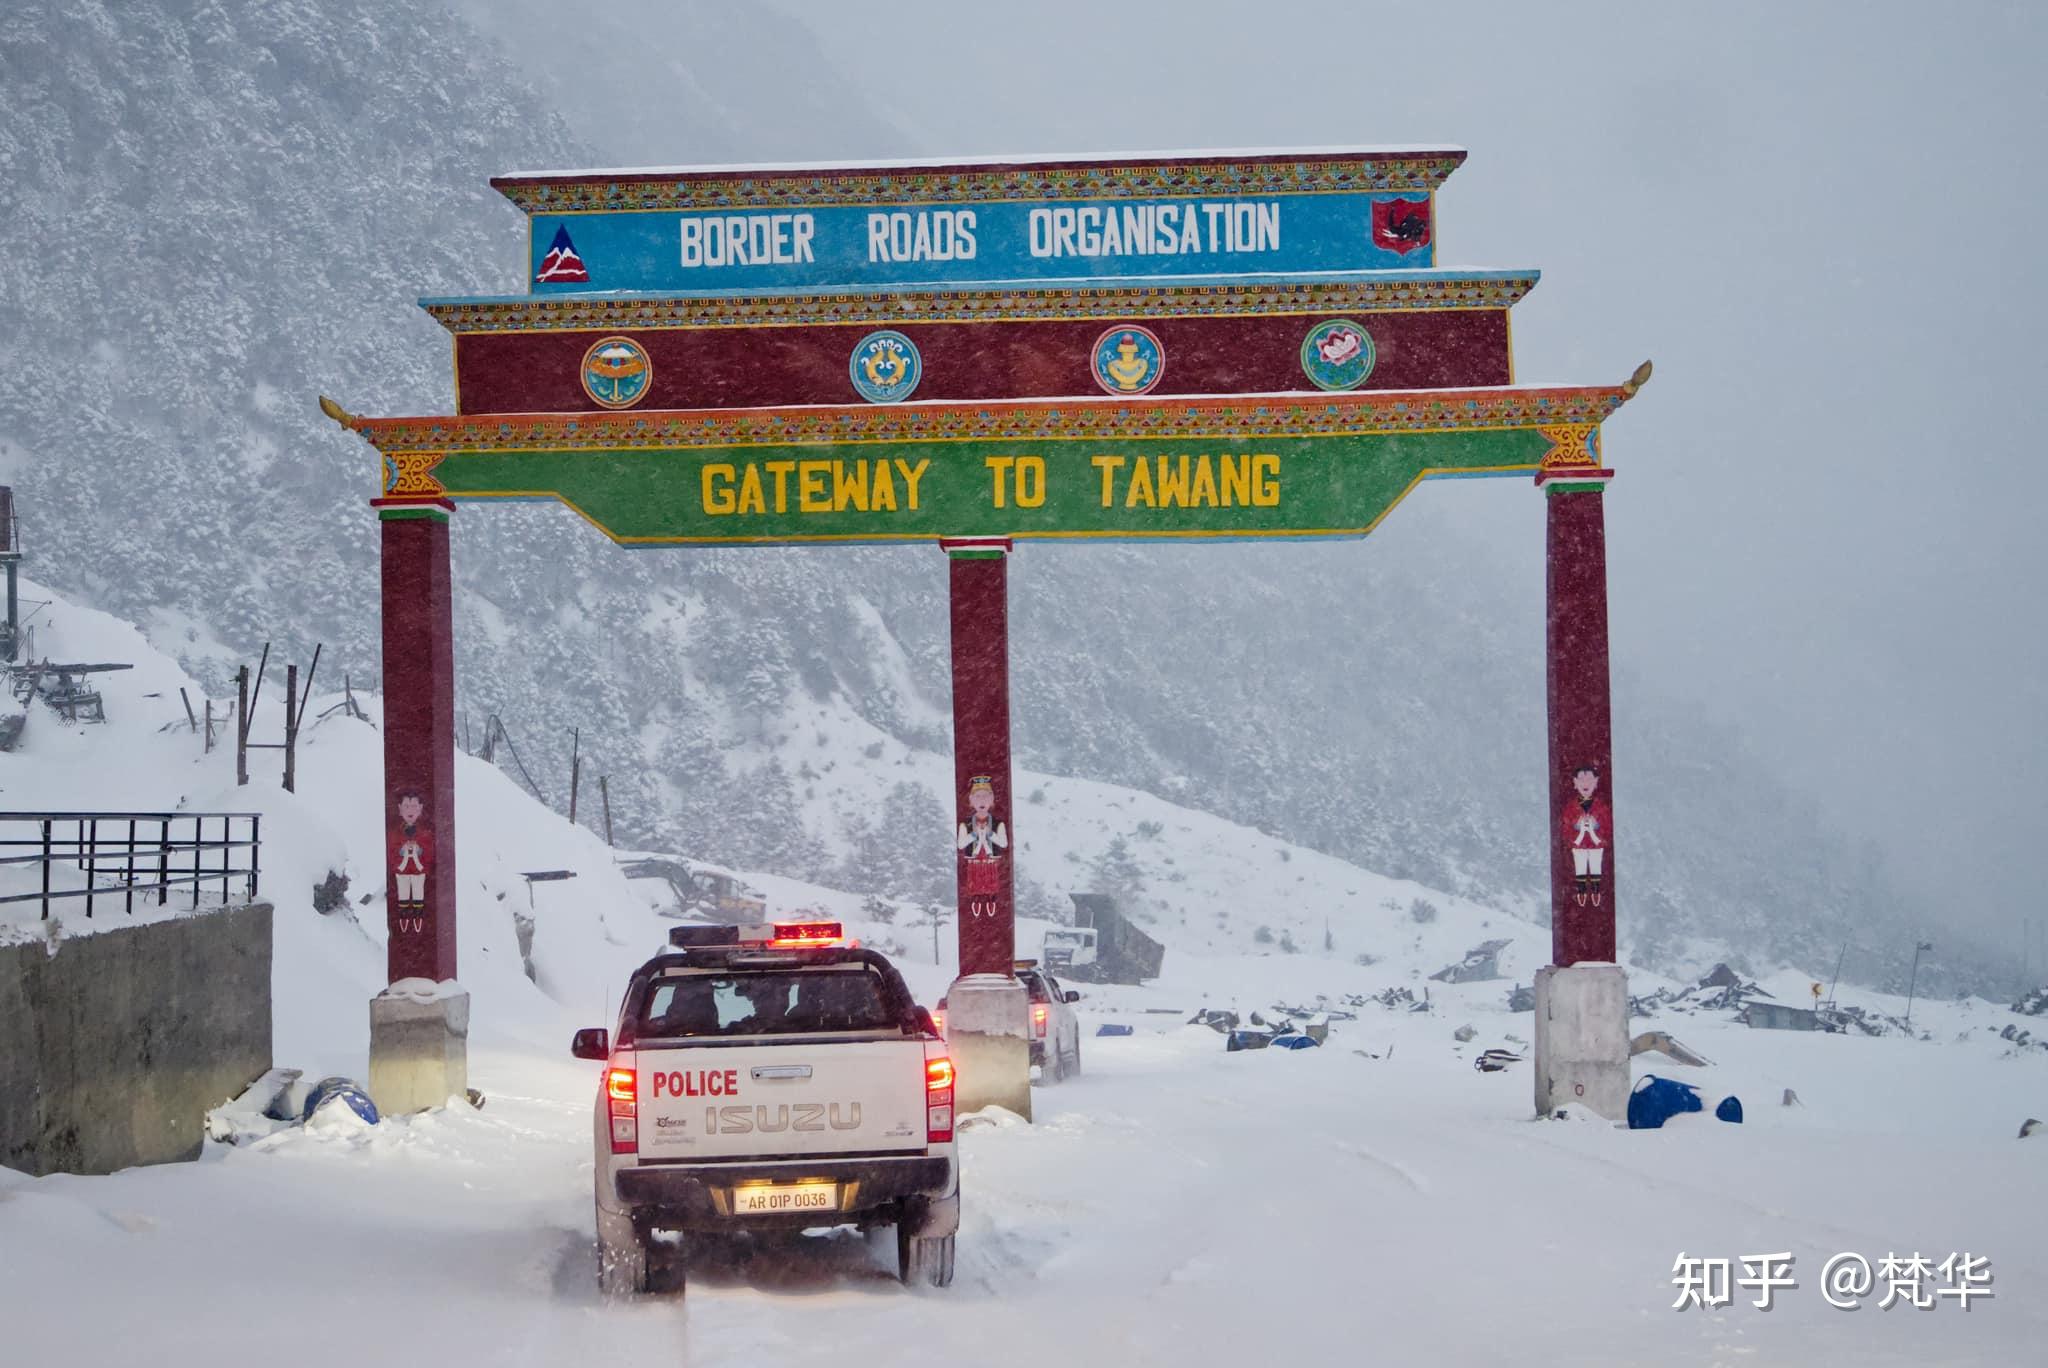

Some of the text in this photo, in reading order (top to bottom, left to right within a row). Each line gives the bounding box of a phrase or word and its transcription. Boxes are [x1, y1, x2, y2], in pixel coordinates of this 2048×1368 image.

[680, 202, 1280, 268] BORDER ROADS ORGANISATION
[701, 454, 1281, 515] GATEWAY TO TAWANG
[653, 1070, 738, 1097] POLICE
[705, 1102, 862, 1135] ISUZU
[748, 1192, 827, 1209] AR 01P 0036
